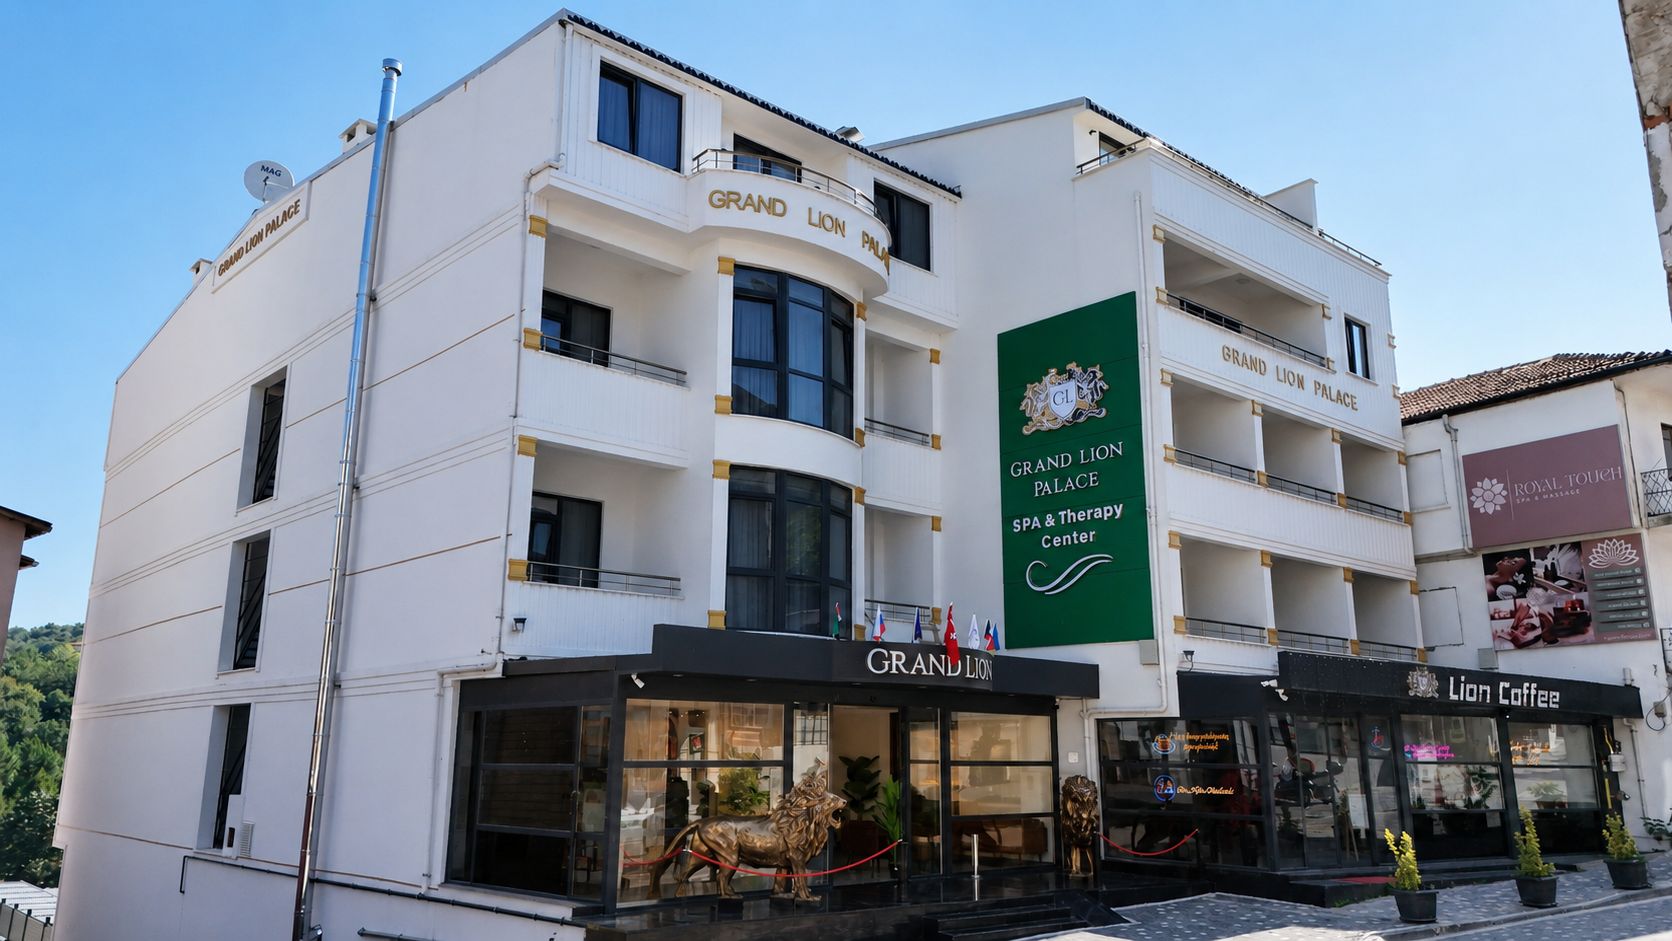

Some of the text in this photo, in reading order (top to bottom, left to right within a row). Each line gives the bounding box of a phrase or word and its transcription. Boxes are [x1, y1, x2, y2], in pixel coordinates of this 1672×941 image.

[260, 165, 282, 177] MAG
[218, 199, 301, 277] GRAND LION PALACE
[708, 189, 890, 276] GRAND LION PALA
[1221, 344, 1359, 411] GRAND LION PALACE
[1053, 389, 1074, 406] GL
[1010, 441, 1124, 477] GRAND LION
[1033, 471, 1100, 497] PALACE
[1513, 465, 1623, 497] ROYAL TOUCH
[1012, 503, 1124, 533] SPA & Therapy
[1041, 530, 1096, 549] Center
[866, 648, 993, 680] GRAND LION
[1449, 675, 1560, 709] Lion Coffee
